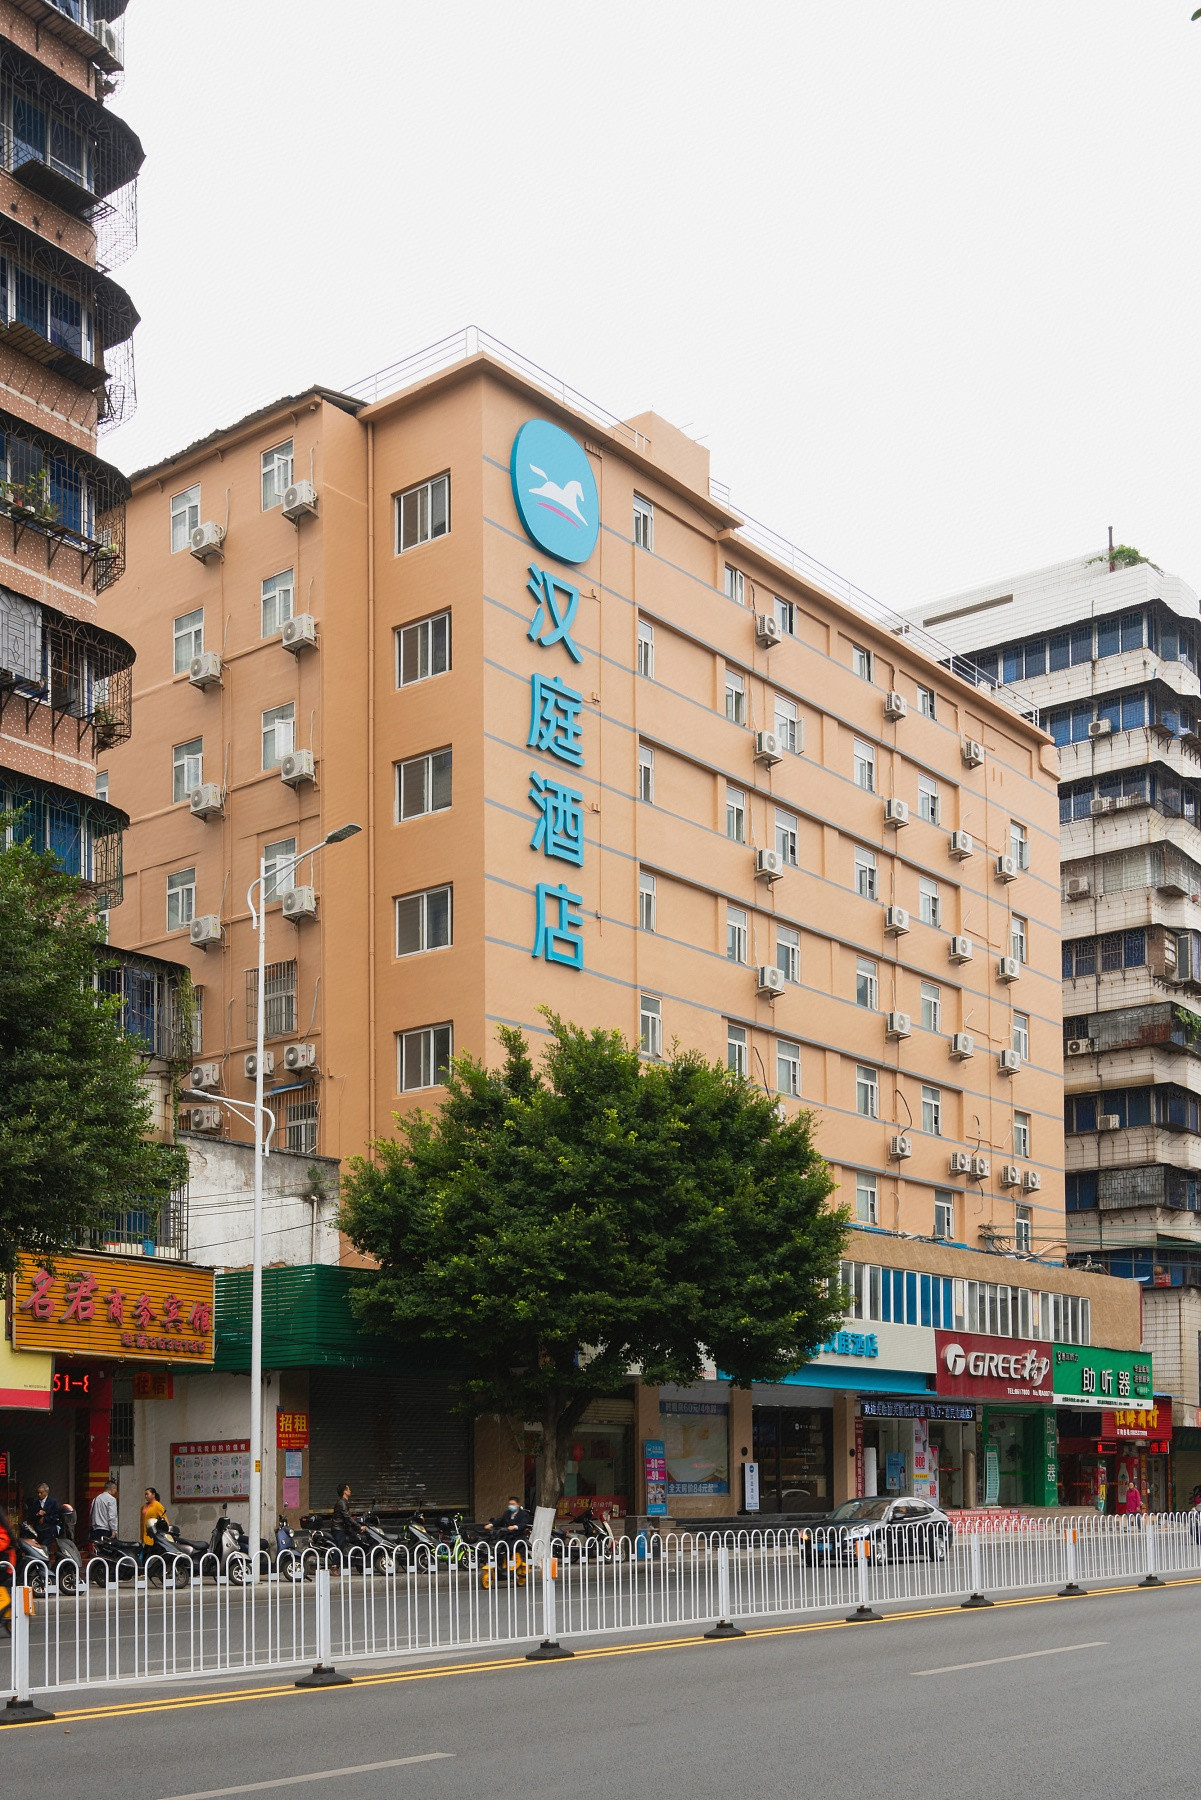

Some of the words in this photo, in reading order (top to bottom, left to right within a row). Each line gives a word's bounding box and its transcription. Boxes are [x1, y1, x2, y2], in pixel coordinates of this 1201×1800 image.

[525, 562, 585, 972] 汉庭酒店
[20, 1268, 213, 1334] 名君商务宾馆
[967, 1351, 1022, 1379] GREE
[1082, 1367, 1131, 1396] 助听器
[279, 1413, 307, 1432] 招租
[1046, 1416, 1056, 1482] 助听器
